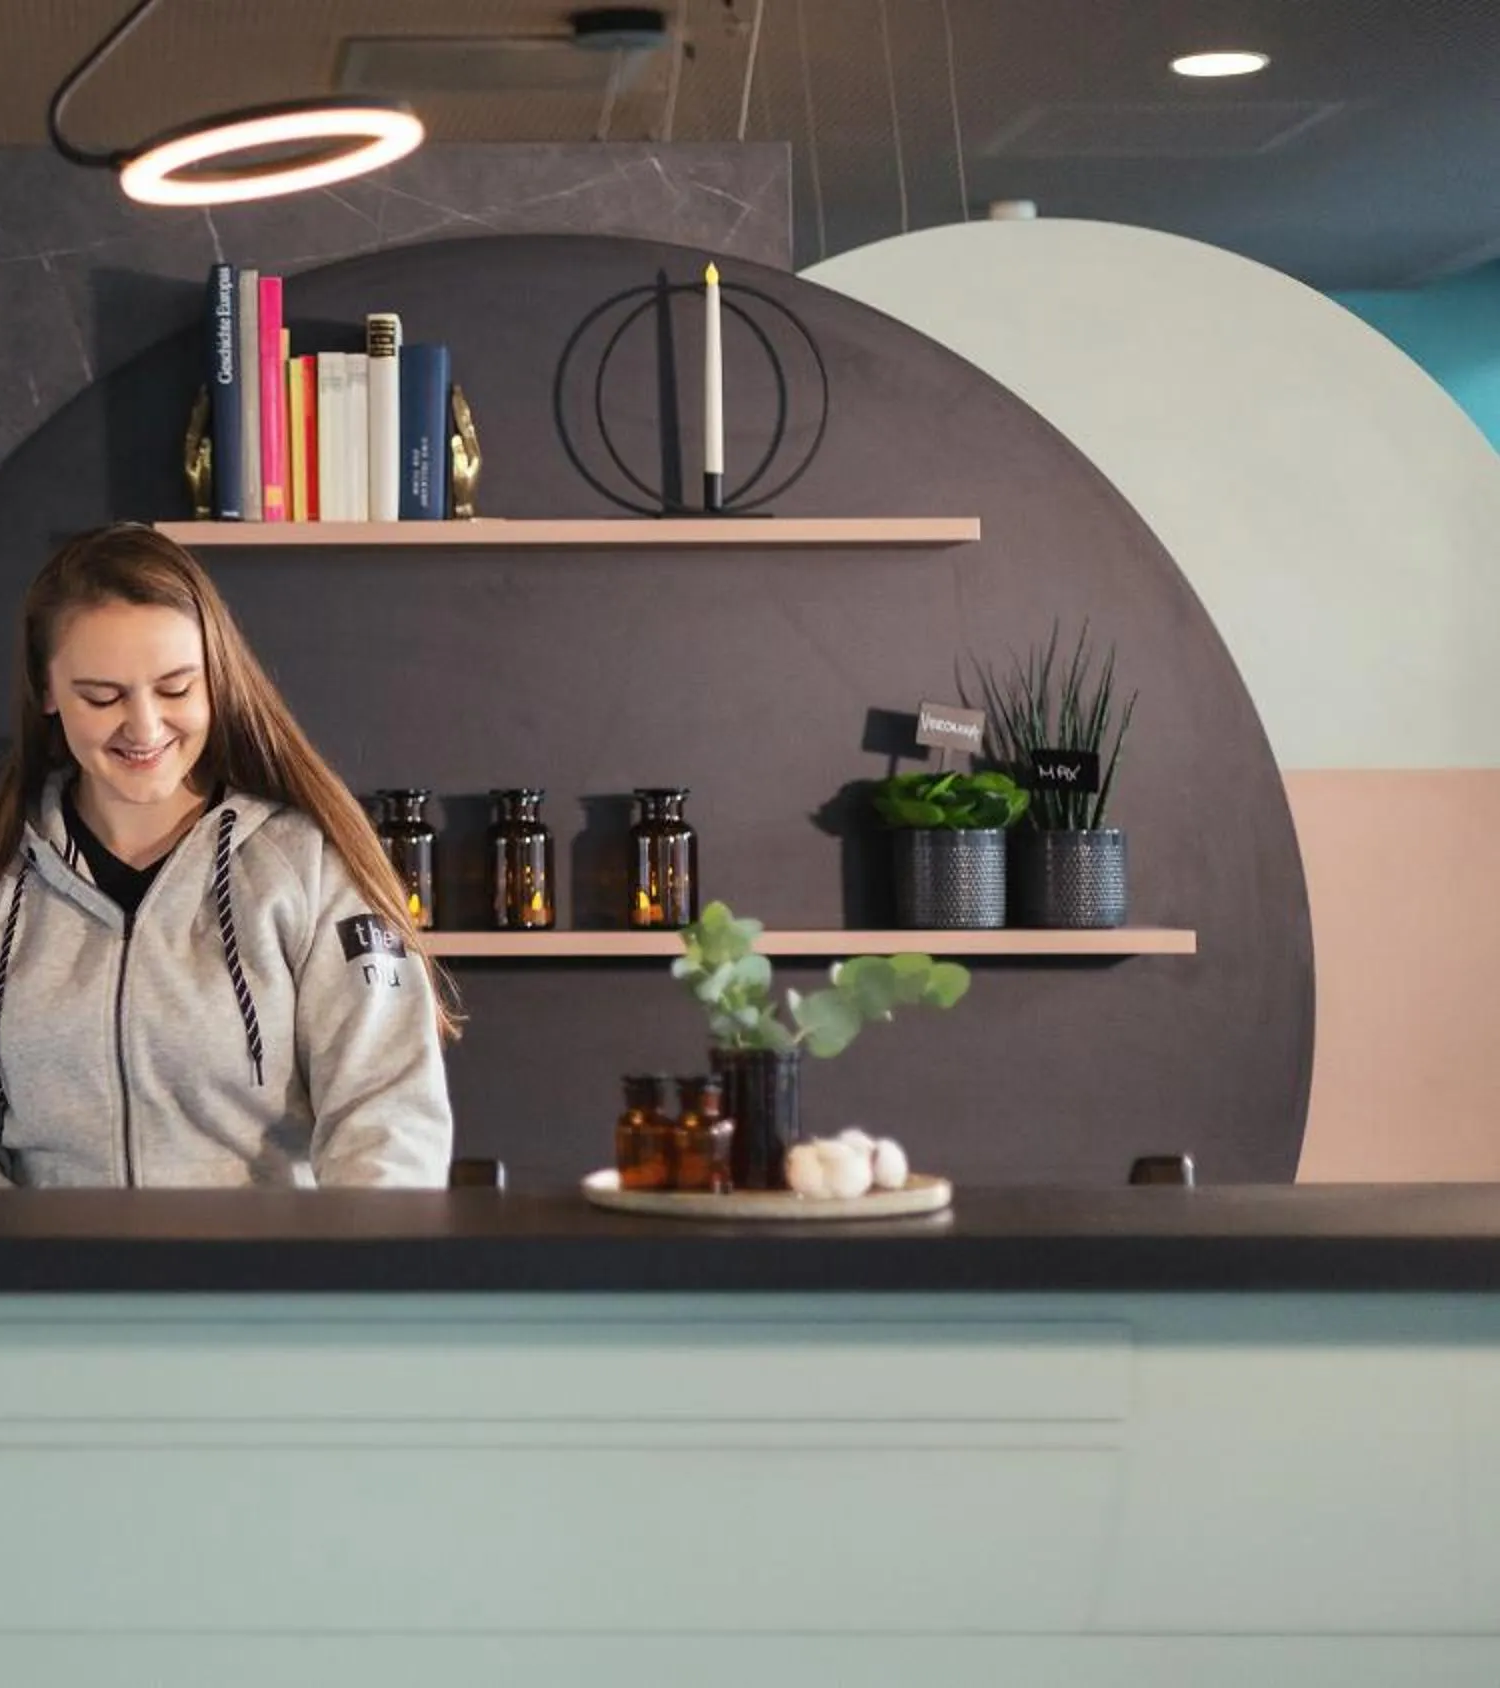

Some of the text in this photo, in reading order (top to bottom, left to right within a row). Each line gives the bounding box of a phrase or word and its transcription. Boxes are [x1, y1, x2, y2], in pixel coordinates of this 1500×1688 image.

[216, 317, 233, 384] Geschichte
[1038, 764, 1081, 782] MAX
[355, 920, 396, 949] the
